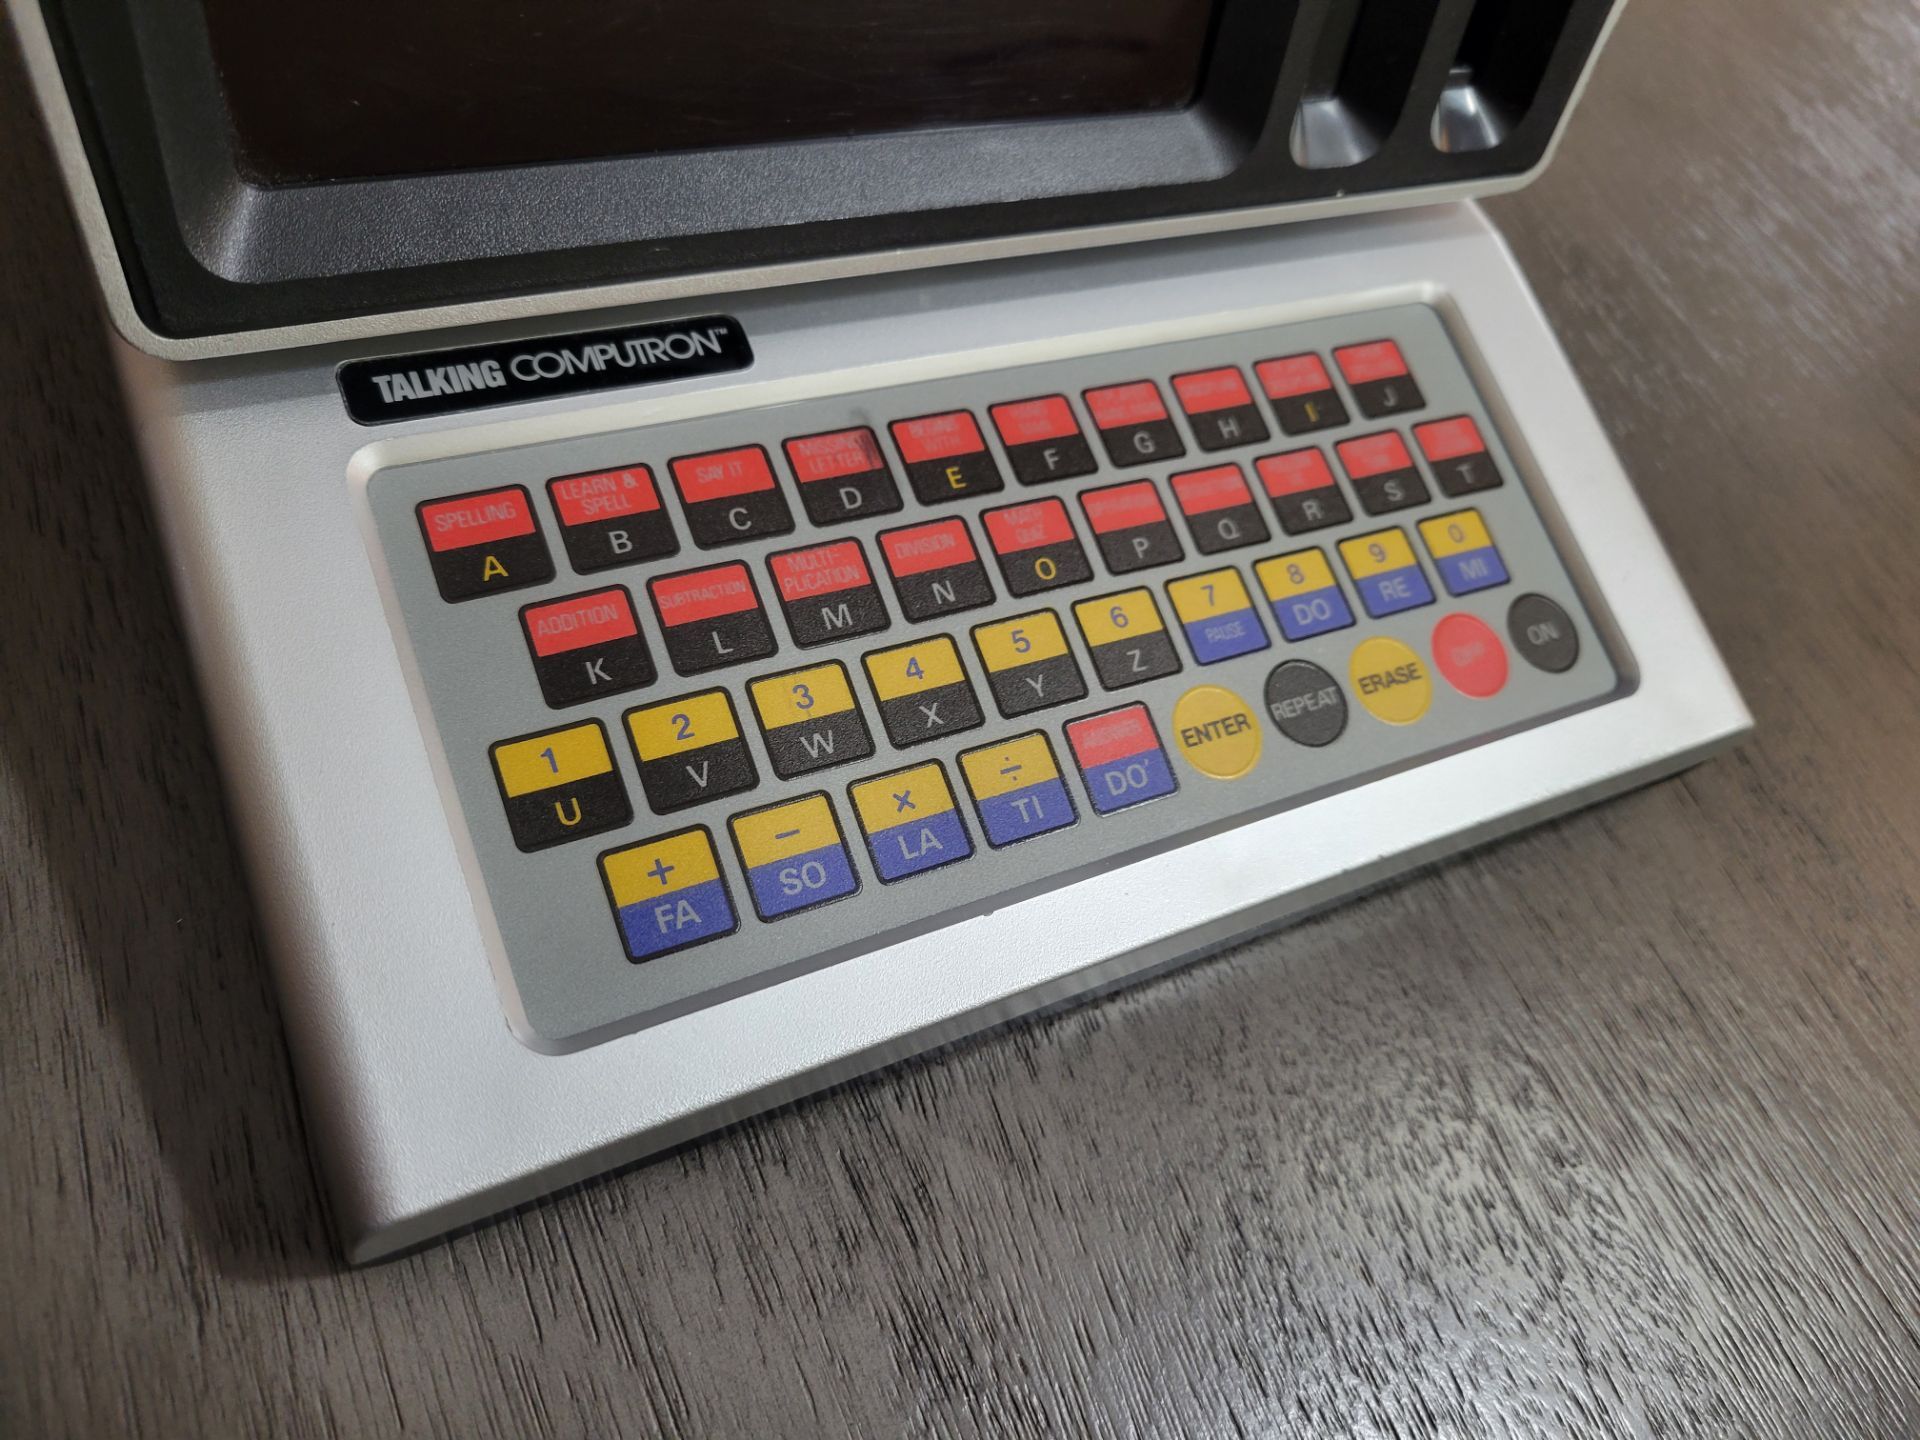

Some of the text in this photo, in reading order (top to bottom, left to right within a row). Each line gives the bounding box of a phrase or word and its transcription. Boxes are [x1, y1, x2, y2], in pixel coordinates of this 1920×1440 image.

[372, 359, 507, 404] TALKING
[1383, 384, 1401, 407] J
[1304, 401, 1320, 423] I
[1217, 417, 1240, 440] H
[1132, 430, 1156, 454] G
[695, 459, 745, 484] SAY IT
[808, 452, 864, 475] LETTER
[1042, 447, 1061, 471] F
[560, 472, 639, 501] LEARN &
[945, 466, 967, 490] E
[1455, 463, 1475, 485] T
[839, 487, 863, 510] D
[1383, 479, 1405, 502] S
[434, 501, 517, 533] SPELLING
[581, 494, 633, 516] SPELL
[1302, 499, 1325, 521] R
[728, 507, 753, 531] C
[1217, 517, 1241, 540] Q
[608, 530, 634, 555] B
[893, 532, 956, 560] DIVISION
[1131, 536, 1149, 559] P
[1368, 542, 1387, 564] 9
[482, 555, 509, 582] A
[783, 565, 861, 597] PLICATION
[1034, 557, 1057, 581] O
[1286, 562, 1306, 585] 8
[1457, 558, 1490, 581] MI
[658, 579, 747, 610] SUBTRACTION
[931, 579, 957, 605] N
[1201, 584, 1217, 606] 7
[1378, 576, 1410, 603] RE
[536, 602, 619, 637] ADDITION
[820, 603, 854, 631] M
[1110, 605, 1130, 629] 6
[1291, 598, 1332, 626] DO
[711, 631, 734, 655] L
[1011, 629, 1031, 654] 5
[1204, 619, 1248, 643] PAUSE
[1526, 621, 1559, 647] ON
[584, 657, 613, 685] K
[905, 656, 925, 680] 4
[1125, 648, 1150, 673] Z
[1025, 672, 1045, 698] Y
[1357, 662, 1424, 696] ERASE
[792, 684, 815, 710] 3
[1269, 685, 1340, 723] REPEAT
[671, 713, 695, 741] 2
[919, 702, 945, 729] X
[799, 729, 835, 759] W
[1180, 713, 1252, 749] ENTER
[540, 747, 560, 774] 1
[685, 760, 710, 788] V
[556, 797, 582, 827] U
[1010, 795, 1045, 824] TI
[897, 828, 943, 861] LA
[778, 861, 827, 896] SO
[654, 899, 702, 935] FA
